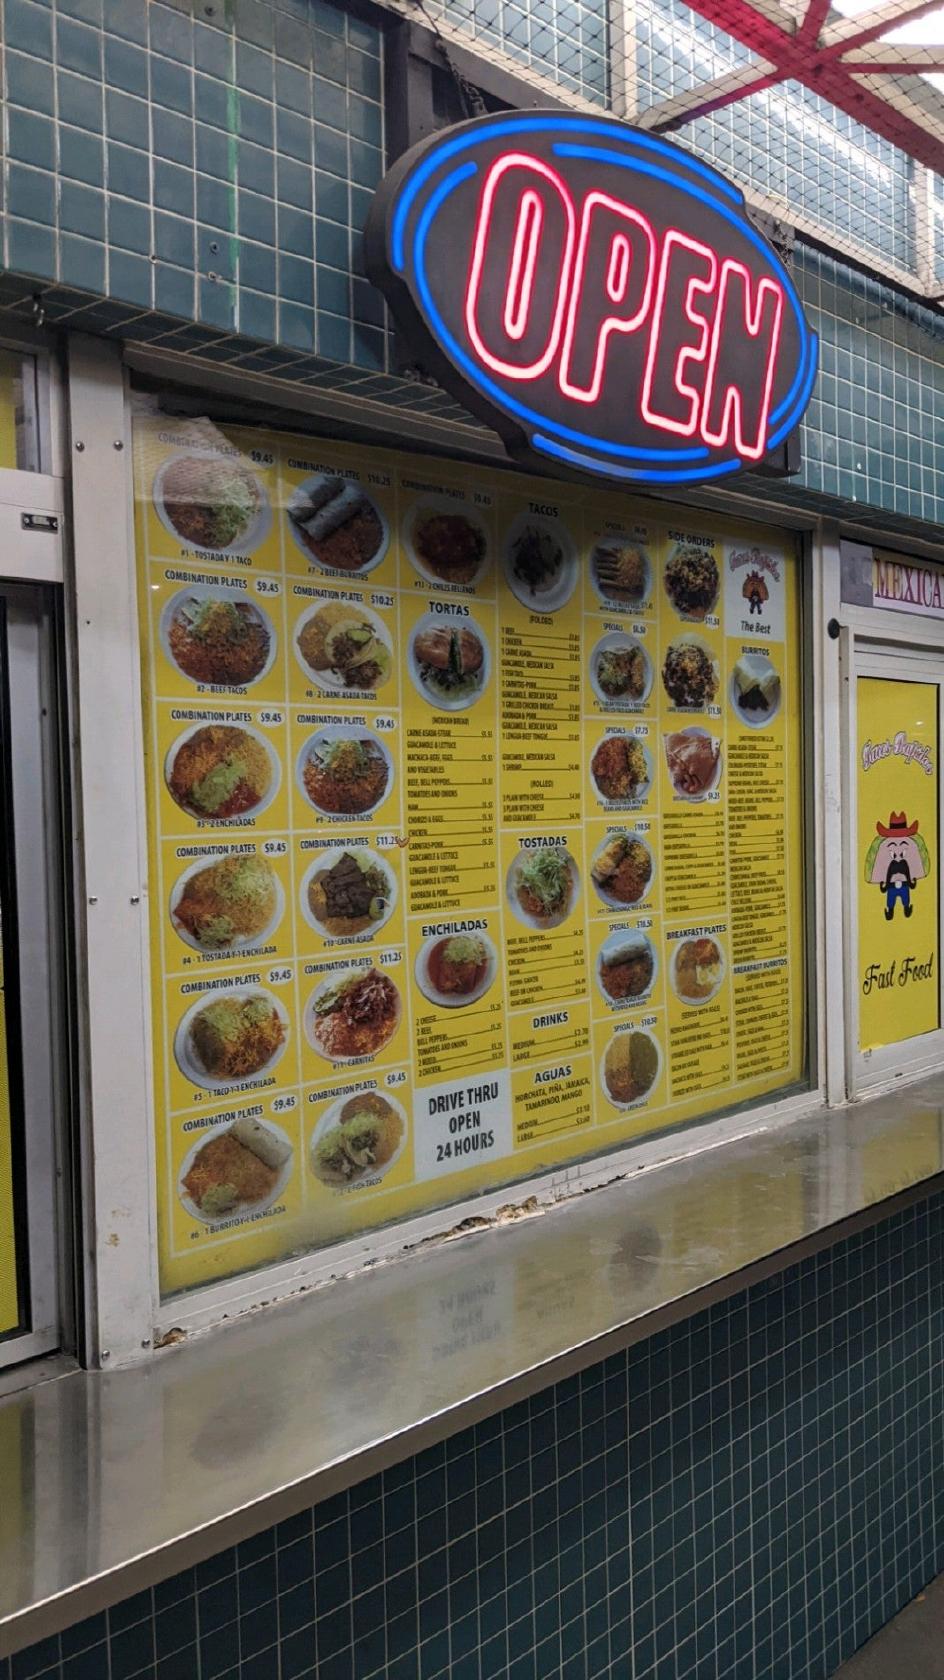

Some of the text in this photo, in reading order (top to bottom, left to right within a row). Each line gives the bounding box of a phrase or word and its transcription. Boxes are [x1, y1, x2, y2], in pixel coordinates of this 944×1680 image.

[466, 151, 783, 459] OPEN
[251, 450, 273, 464] $9.45
[288, 458, 336, 475] COMBINATION
[336, 468, 360, 480] PLATES
[528, 502, 558, 517] TACOS
[668, 530, 715, 548] SIDE ORDERS
[236, 556, 252, 566] TACO
[165, 569, 279, 593] COMBINATION PLATES $9.45
[873, 557, 944, 610] MEXICA
[293, 586, 394, 606] COMBINATION PLATES $10.25
[429, 600, 470, 616] TORTAS
[741, 621, 771, 634] The Best
[742, 646, 770, 656] BURRITOS
[196, 685, 205, 693] #2
[228, 686, 248, 695] TACOS
[172, 710, 282, 722] COMBINATION PLATES $9.45
[297, 714, 395, 728] COMBINATION PLATES $9.45
[216, 818, 256, 828] ENCHILADAS
[176, 842, 286, 857] COMBINATION PLATES $9.45
[301, 838, 346, 850] COMBINATION
[347, 837, 368, 846] PLATES
[518, 836, 568, 848] TOSTADAS
[422, 919, 488, 937] ENCHILADAS
[666, 924, 727, 940] BREAKFAST PLATES
[182, 956, 191, 964] #4
[202, 952, 231, 962] TOSTADA
[242, 946, 277, 957] ENCHILADA
[305, 952, 402, 974] COMBINATION PLATES $11.25
[181, 970, 292, 994] COMBINATION PLATES $9.45
[862, 960, 896, 996] Fast
[533, 1012, 568, 1028] DRINKS
[348, 1056, 376, 1066] CARNITAS
[534, 1065, 572, 1084] AGUAS
[194, 1093, 202, 1101] #5
[214, 1088, 229, 1097] TACO
[241, 1078, 276, 1091] ENCHILADA
[308, 1072, 406, 1102] COMBINATION PLATES $9.45
[562, 1089, 583, 1101] MANGO
[428, 1082, 499, 1116] DRIVE THRU
[183, 1096, 295, 1132] COMBINATION PLATES $9.45
[449, 1110, 481, 1134] OPEN
[436, 1130, 494, 1162] 24 HOURS
[210, 1220, 238, 1234] BURRITO
[251, 1206, 286, 1223] ENCHILADA
